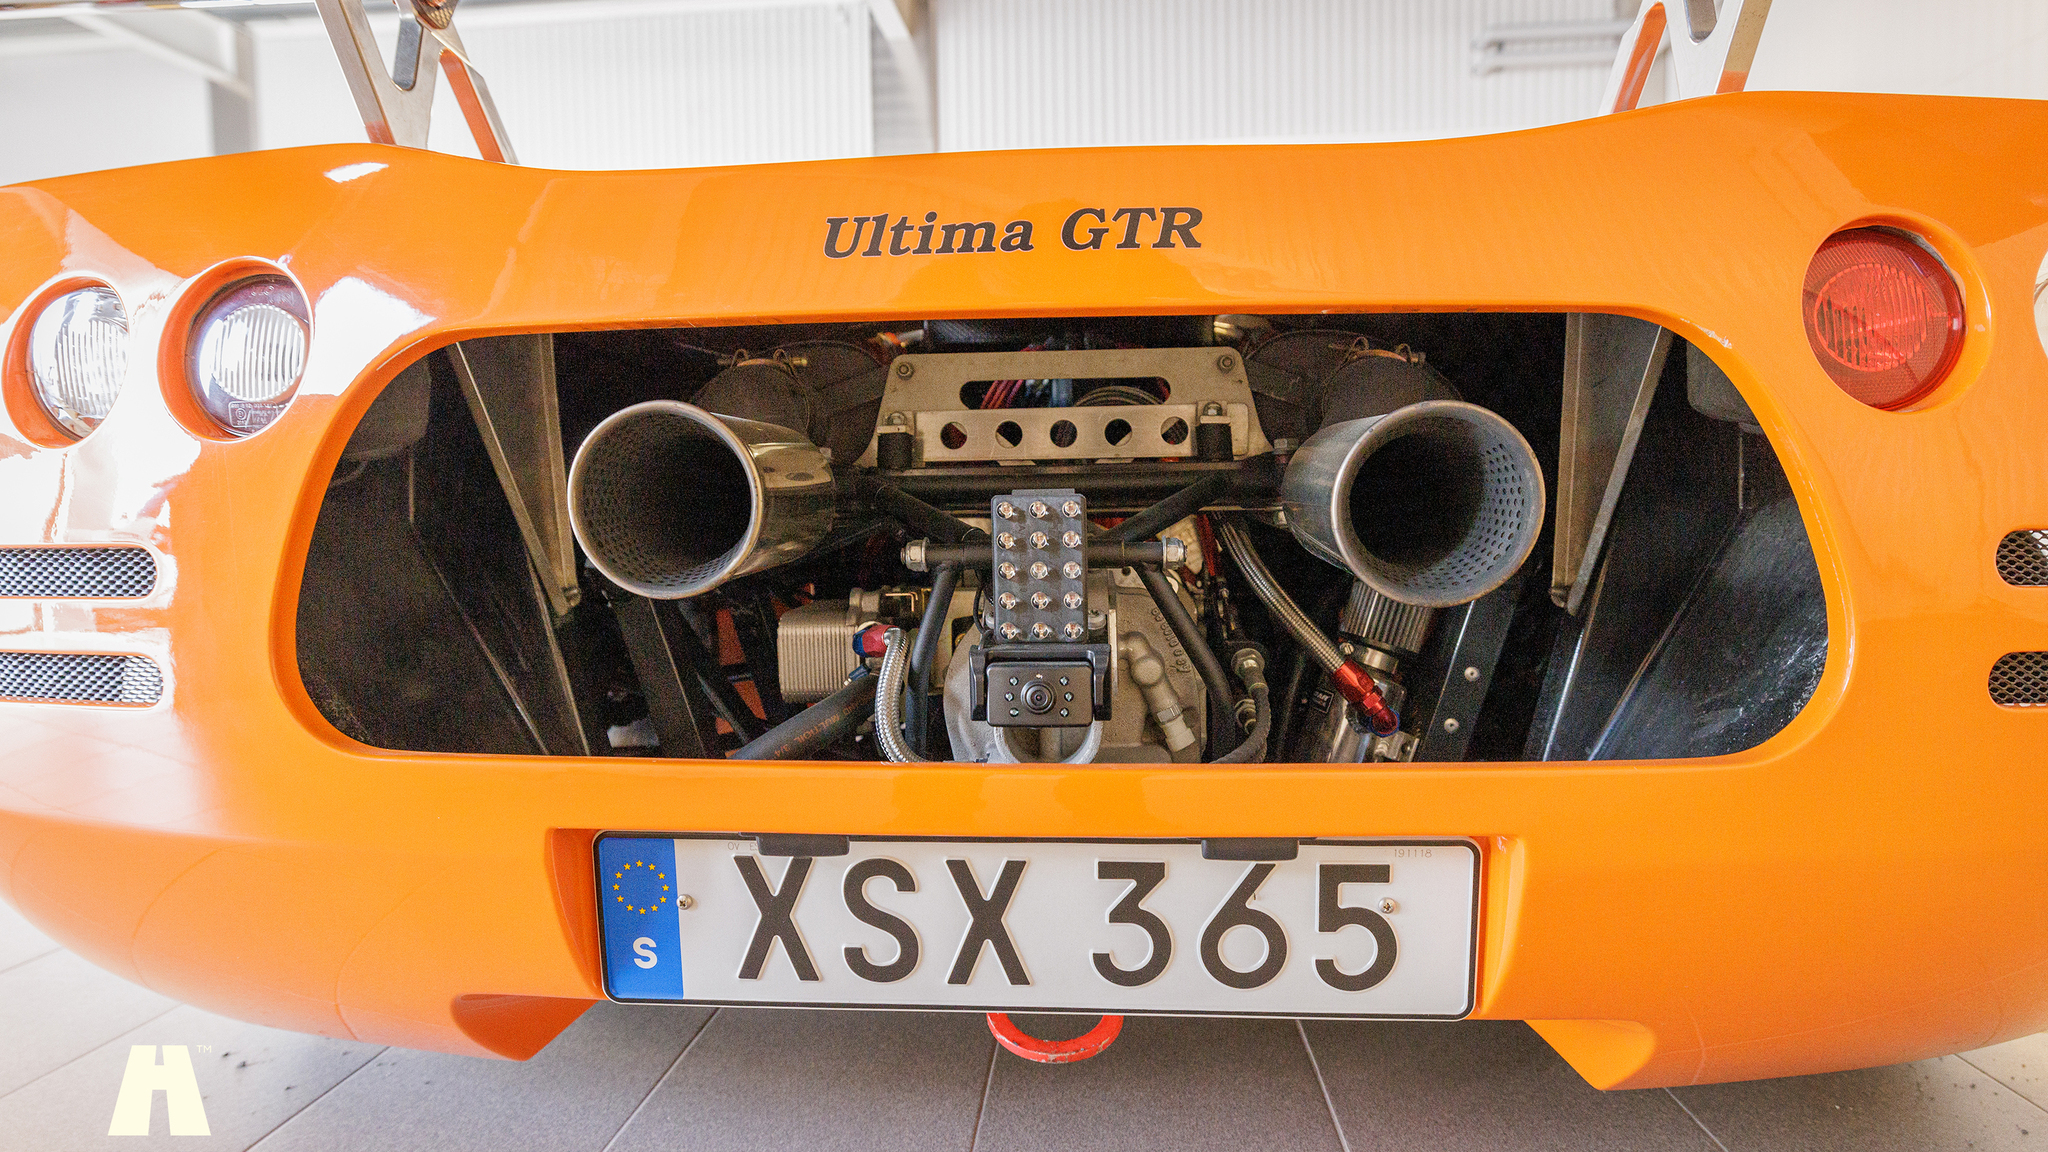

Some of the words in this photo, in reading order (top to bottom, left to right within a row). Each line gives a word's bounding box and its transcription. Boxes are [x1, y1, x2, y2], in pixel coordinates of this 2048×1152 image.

[823, 211, 1034, 258] Ultima
[1061, 207, 1203, 251] GTR
[1394, 848, 1432, 858] 191118
[734, 855, 1032, 986] XSX
[1091, 859, 1399, 992] 365
[633, 937, 658, 969] S
